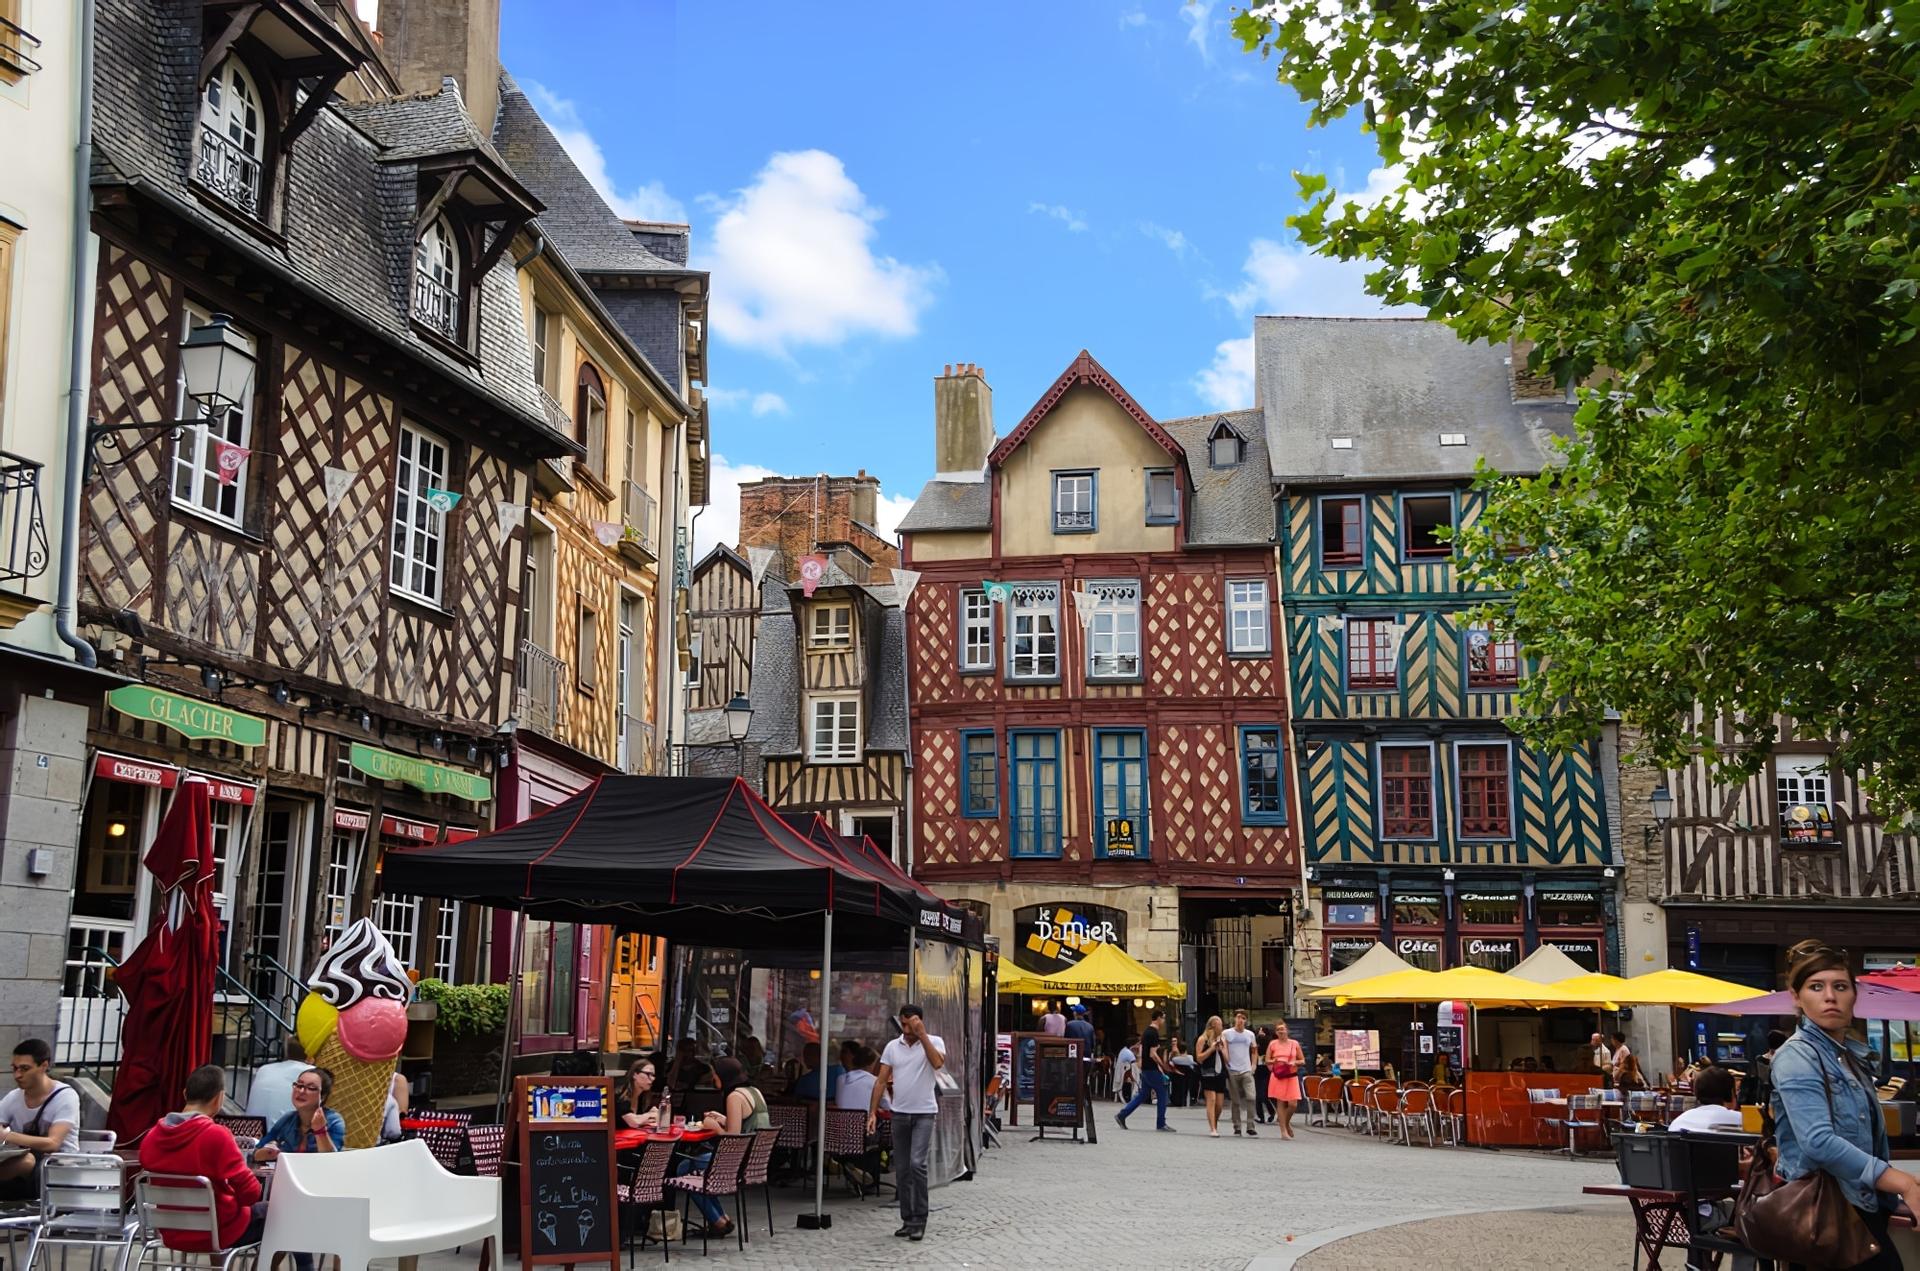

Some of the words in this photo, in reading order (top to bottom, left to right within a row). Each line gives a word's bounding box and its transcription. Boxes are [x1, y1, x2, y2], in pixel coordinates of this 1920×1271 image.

[150, 695, 233, 737] GLACIER
[1039, 906, 1051, 921] le
[1469, 939, 1513, 954] Ouest
